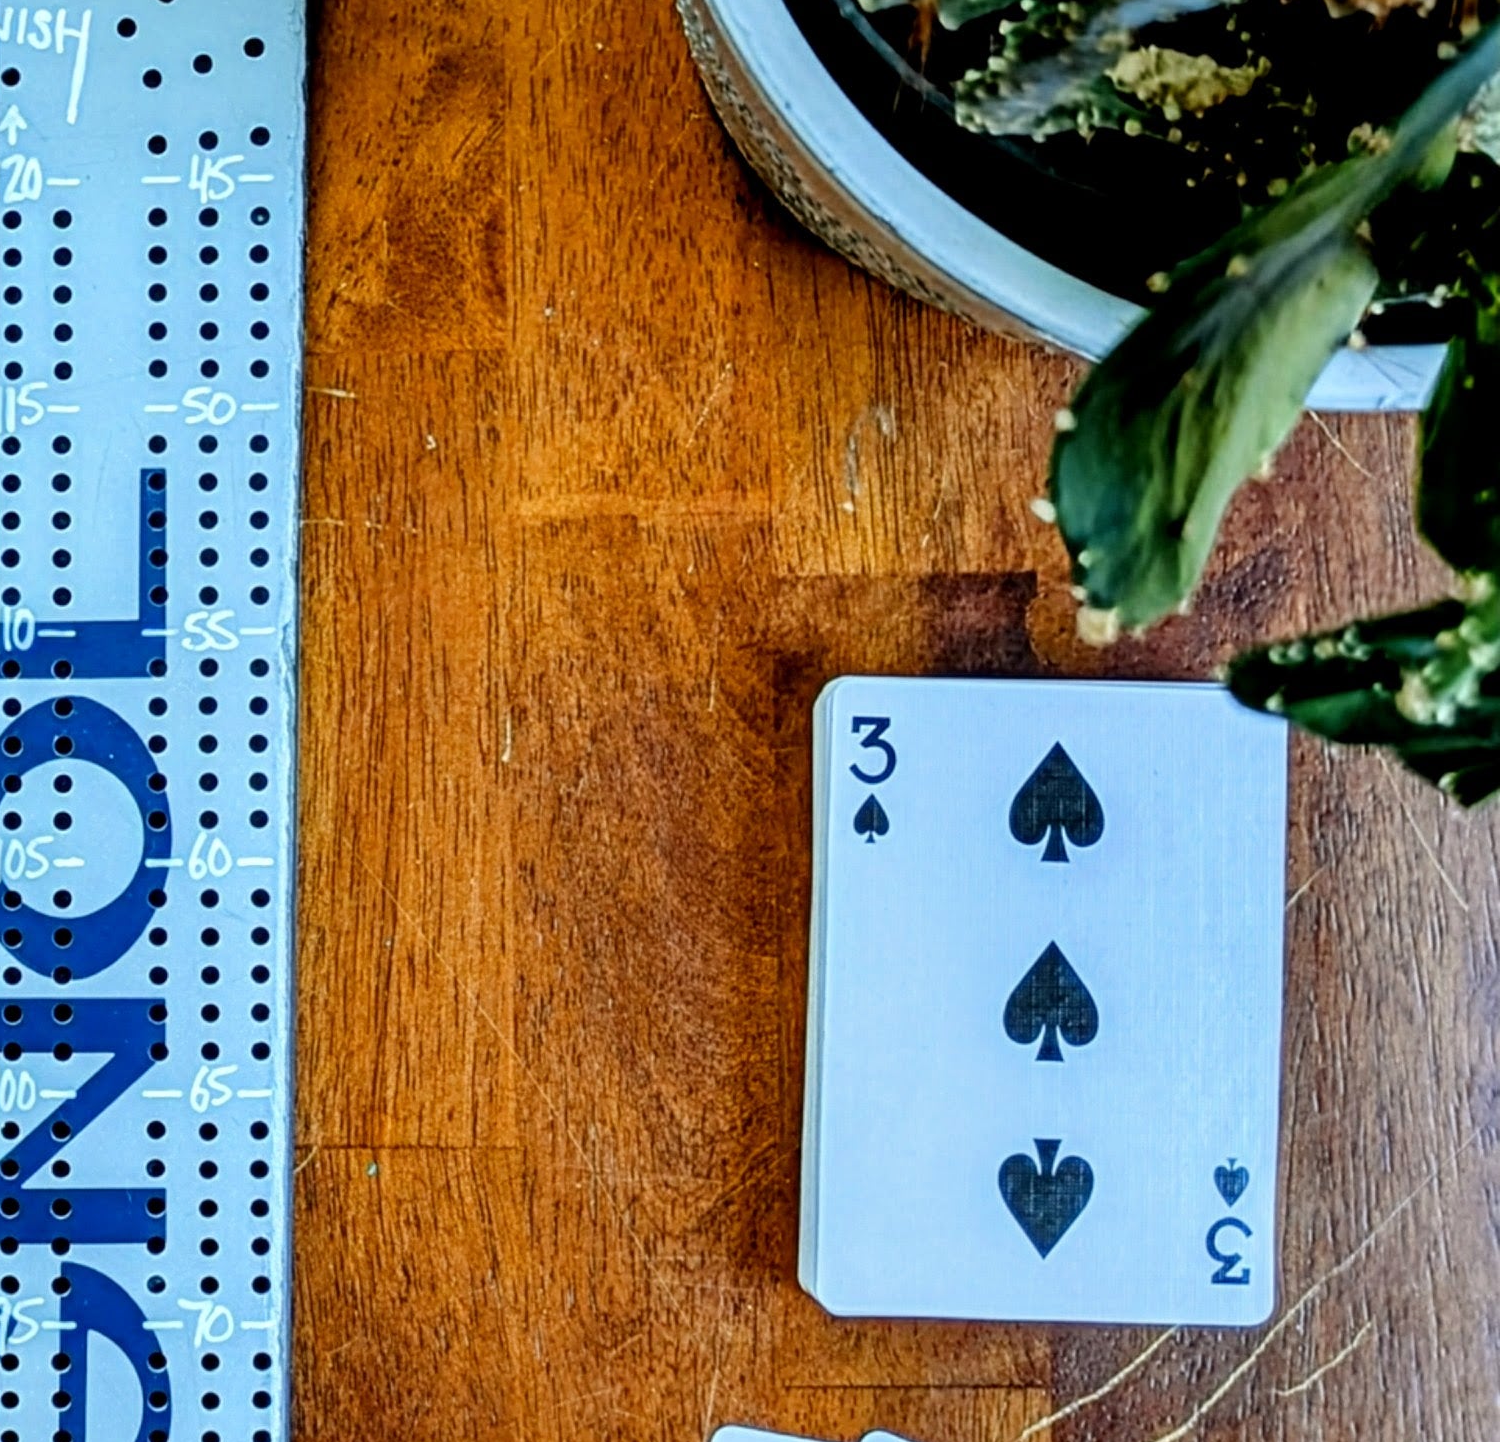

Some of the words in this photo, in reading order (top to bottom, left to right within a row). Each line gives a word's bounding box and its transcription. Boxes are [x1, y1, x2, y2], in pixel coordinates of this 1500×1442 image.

[189, 156, 244, 201] 45
[183, 389, 236, 425] 50
[182, 610, 240, 649] 55
[848, 716, 896, 784] 3
[188, 833, 233, 878] 60
[190, 1065, 239, 1112] 65
[1206, 1217, 1254, 1284] 3
[179, 1301, 234, 1350] 70
